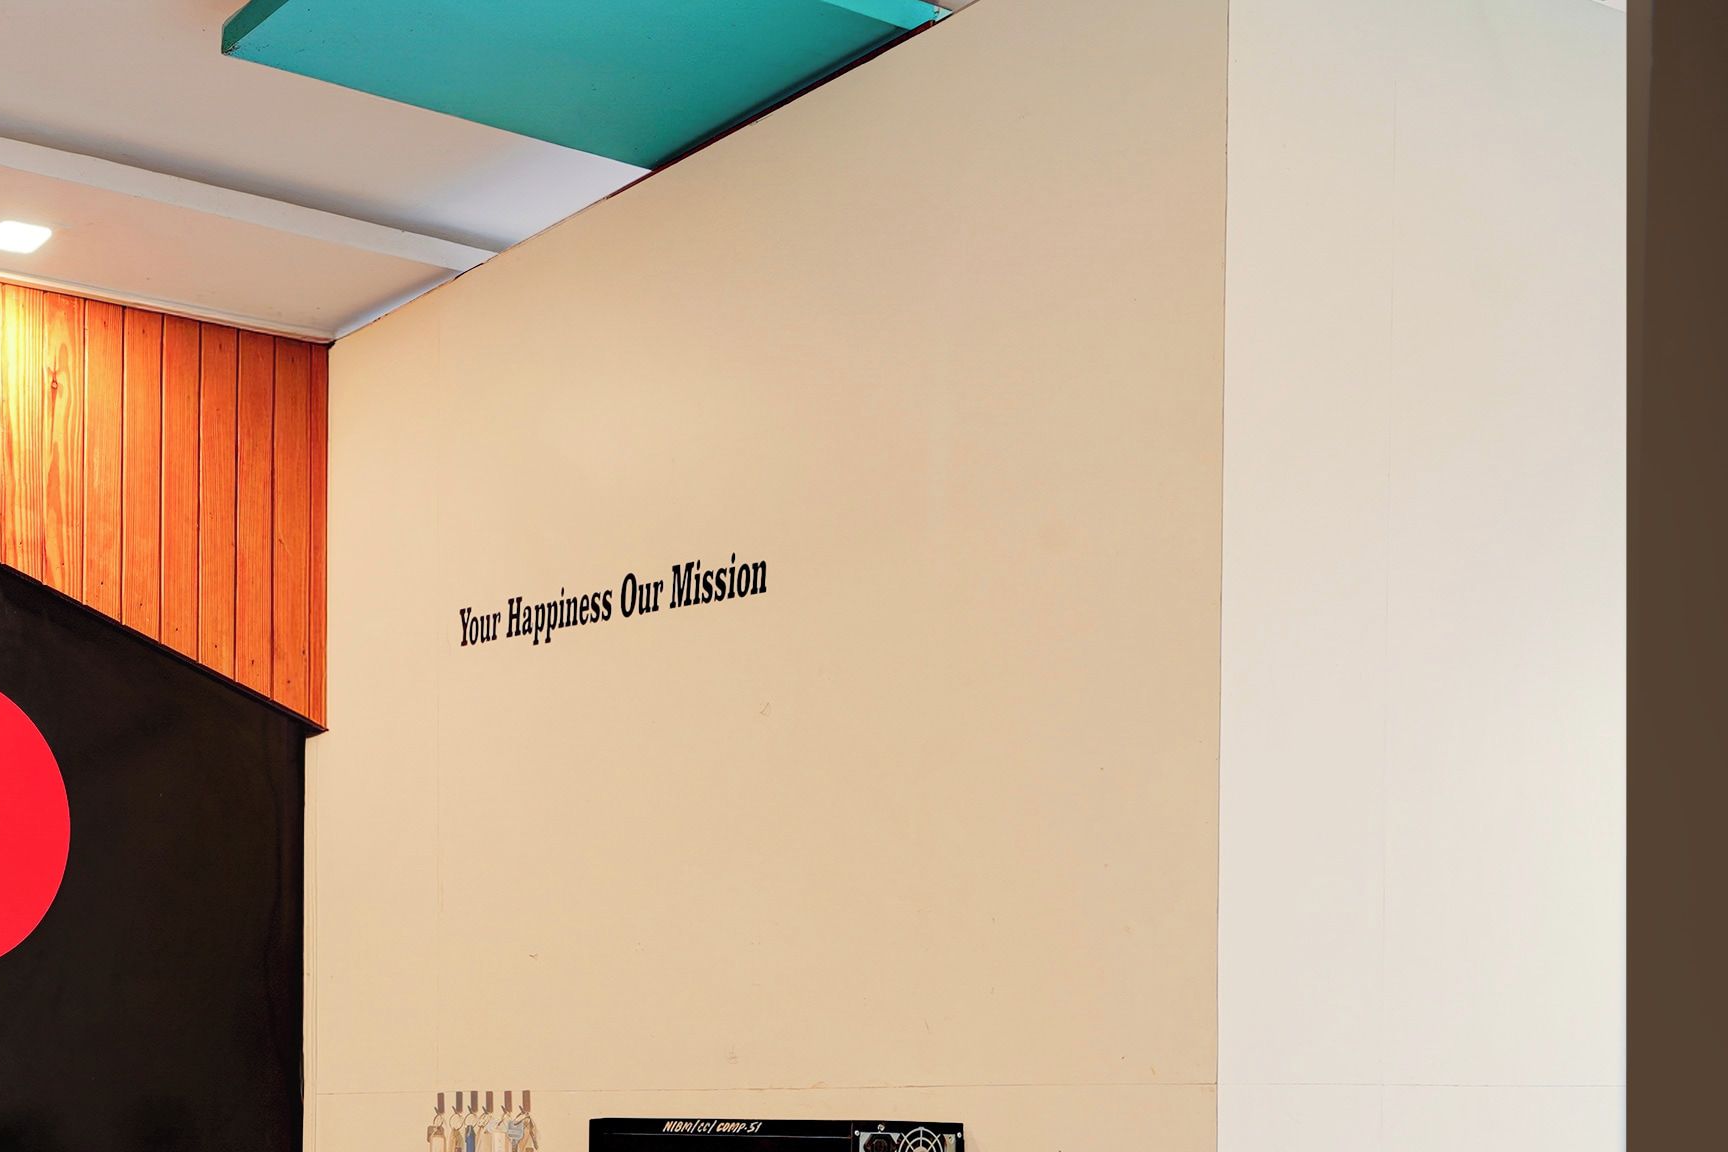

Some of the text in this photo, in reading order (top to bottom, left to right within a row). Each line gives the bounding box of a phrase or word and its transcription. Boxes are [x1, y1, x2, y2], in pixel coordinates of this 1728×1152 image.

[459, 552, 768, 647] Your Happiness Our Mission
